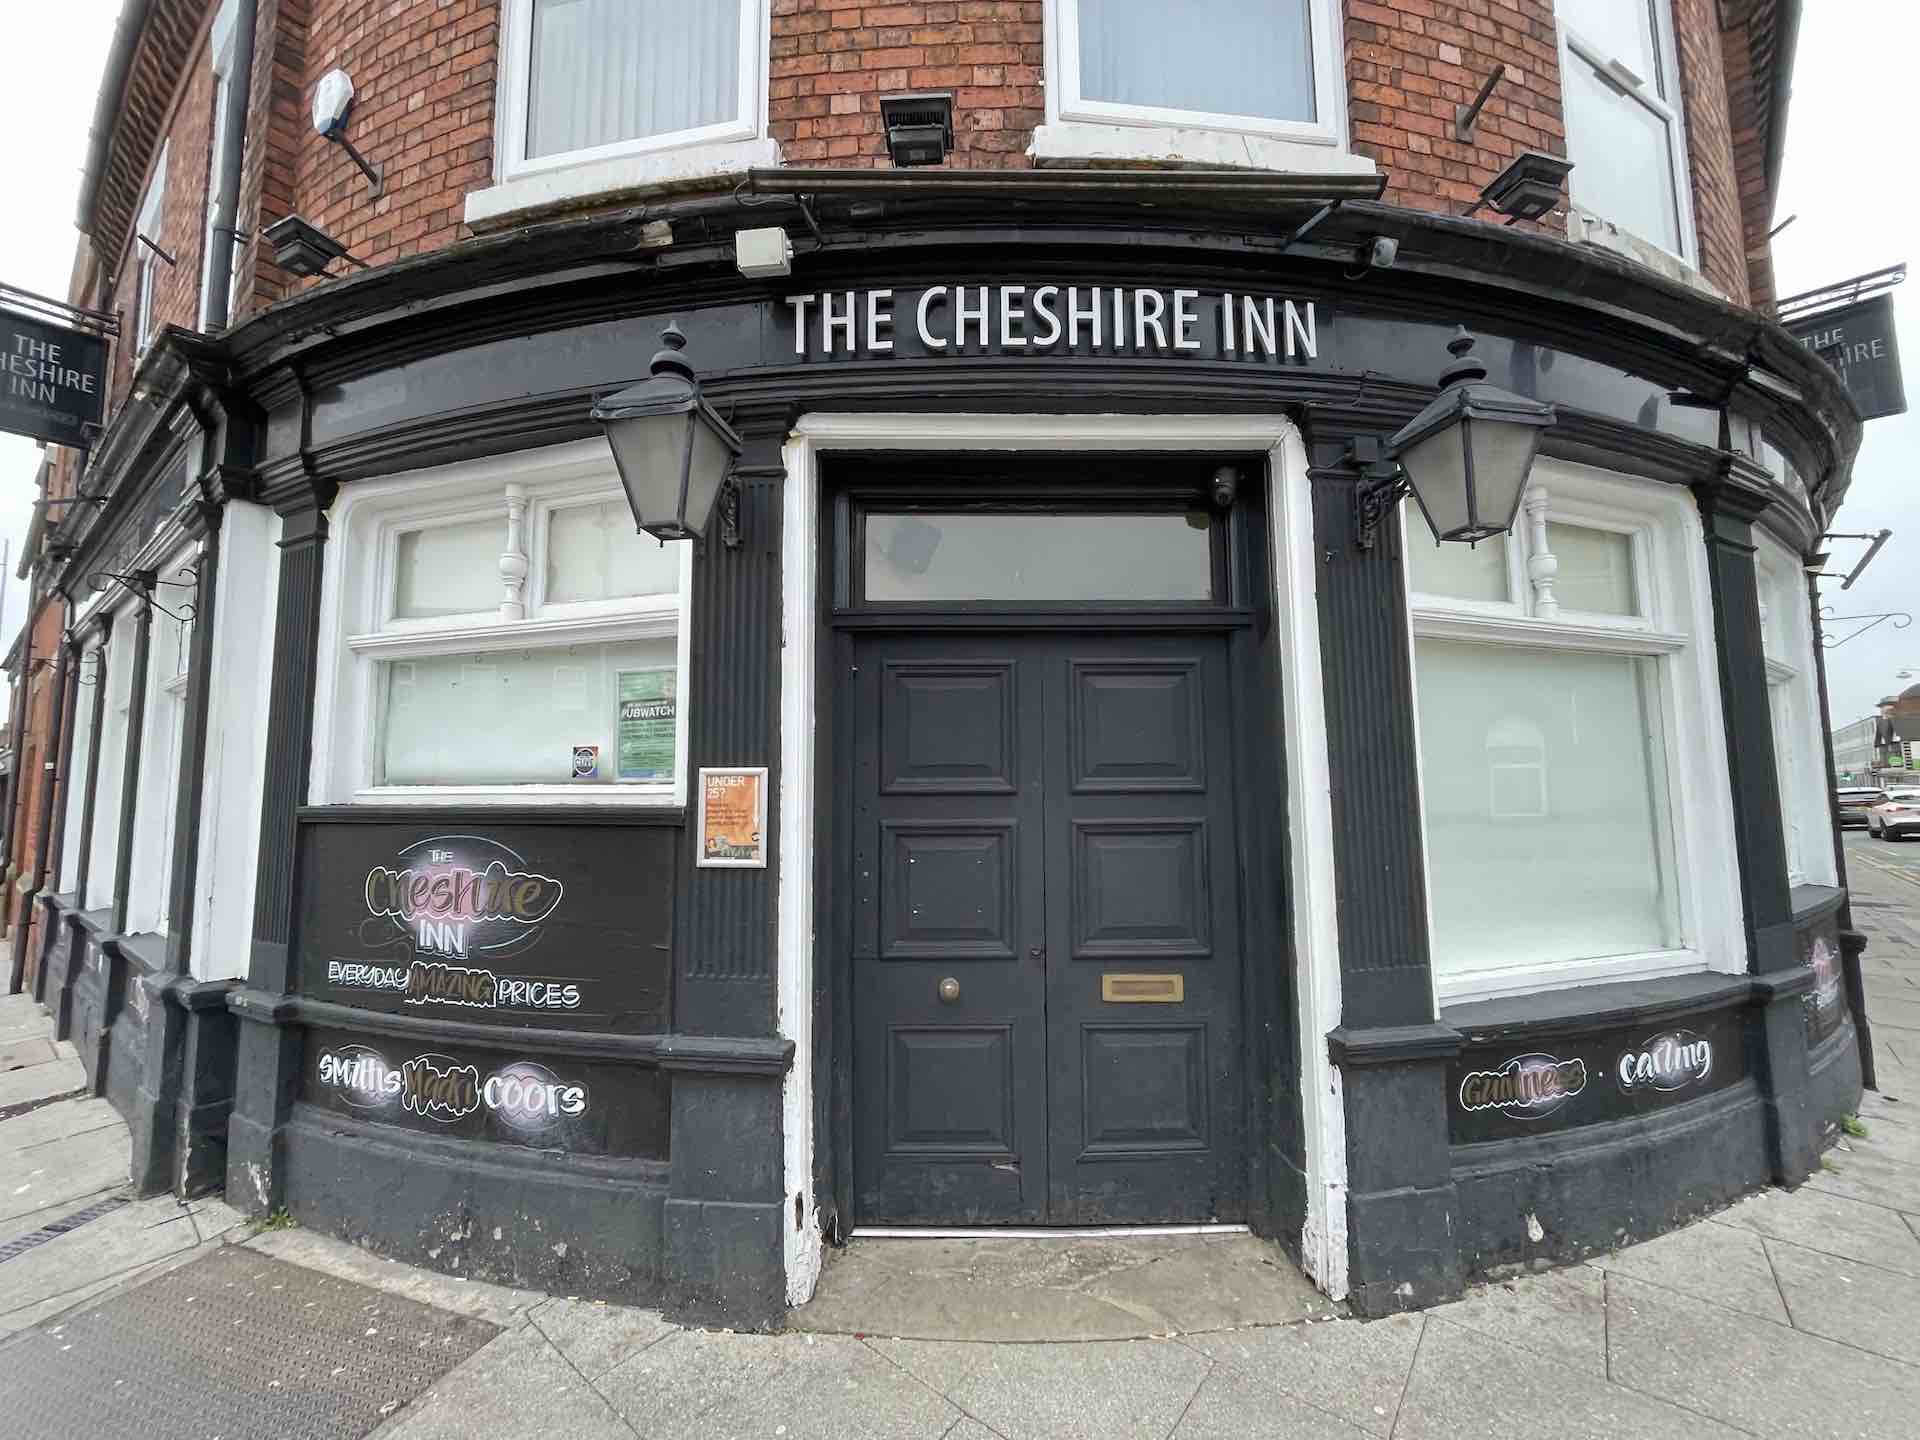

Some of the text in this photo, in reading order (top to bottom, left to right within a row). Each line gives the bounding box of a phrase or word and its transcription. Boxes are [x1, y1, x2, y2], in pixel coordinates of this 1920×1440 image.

[786, 285, 1317, 358] THE CHESHIRE INN
[13, 333, 62, 365] THE
[10, 375, 56, 404] INN
[622, 705, 675, 719] PUBWATCH
[707, 775, 745, 787] UNDER
[429, 849, 453, 863] THE
[418, 919, 466, 957] INN
[328, 960, 580, 1008] EVERYDAY AMAZING PRICES
